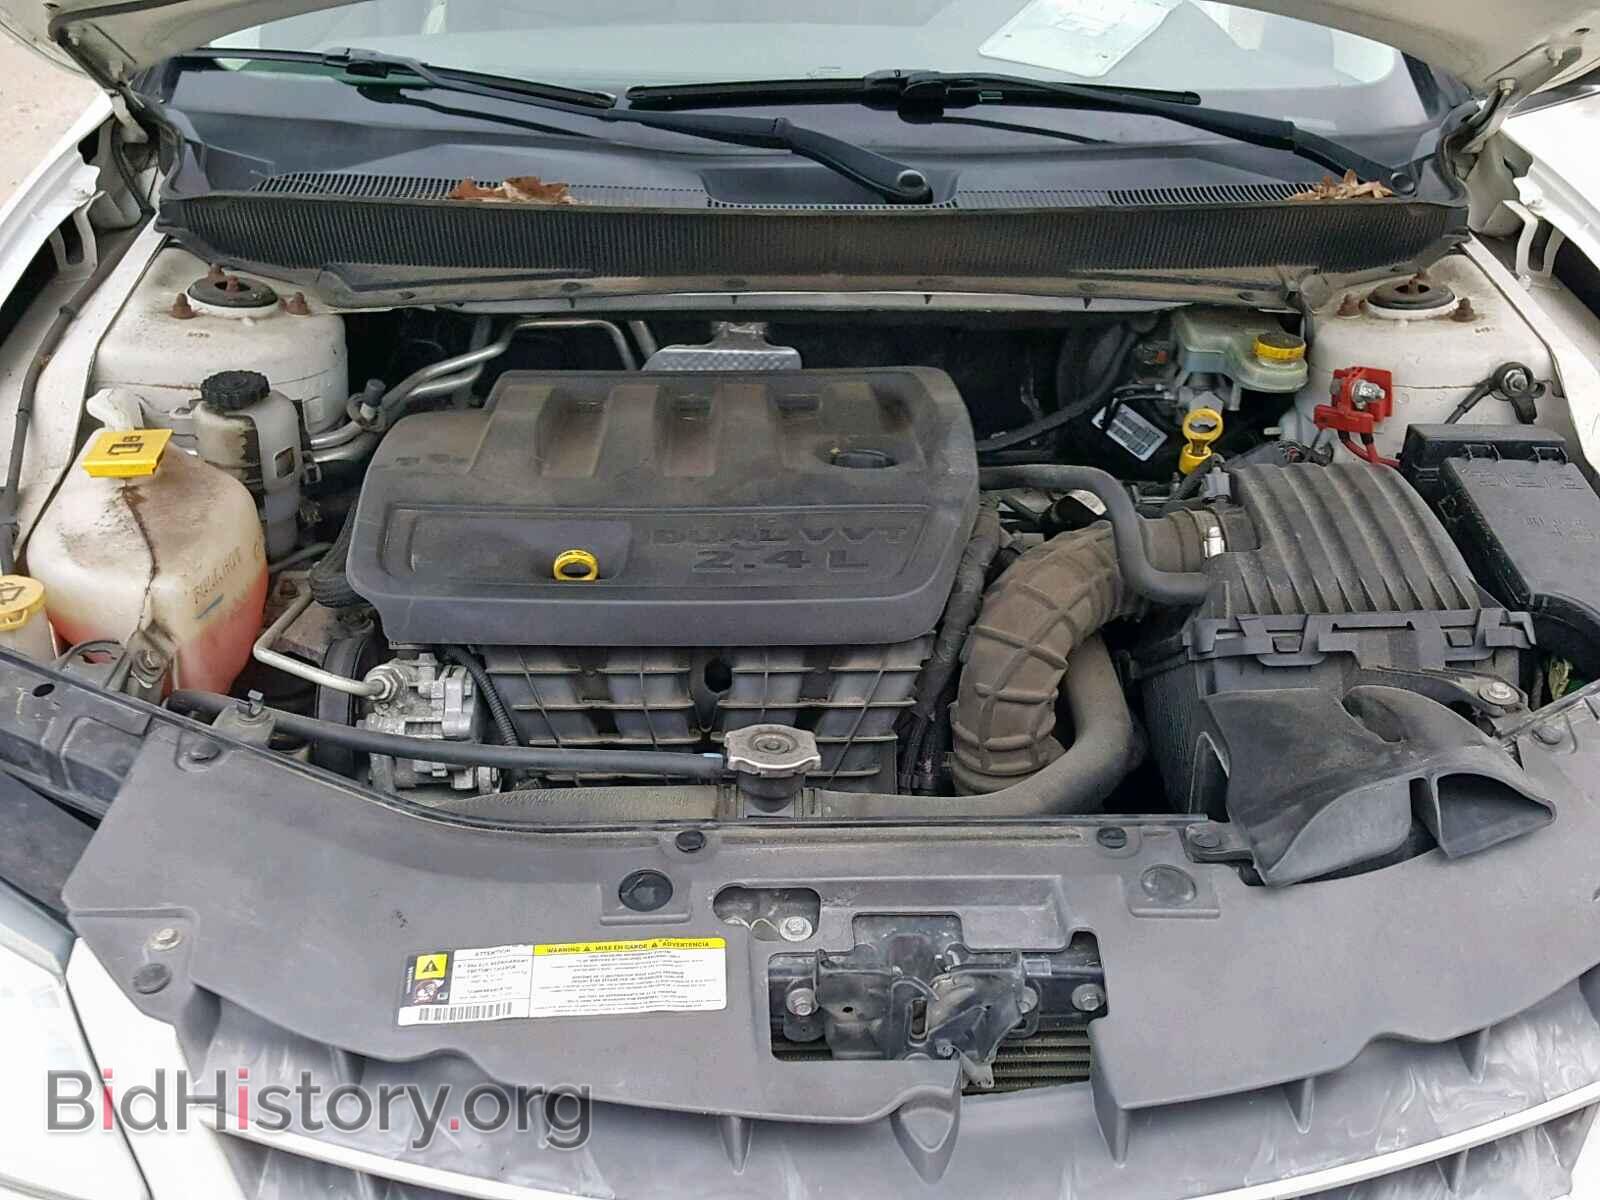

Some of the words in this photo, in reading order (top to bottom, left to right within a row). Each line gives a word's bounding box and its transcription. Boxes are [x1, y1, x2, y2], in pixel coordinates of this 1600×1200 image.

[800, 526, 907, 545] VVT
[691, 548, 871, 573] 2.4L
[662, 941, 709, 949] ADVERTENCIA
